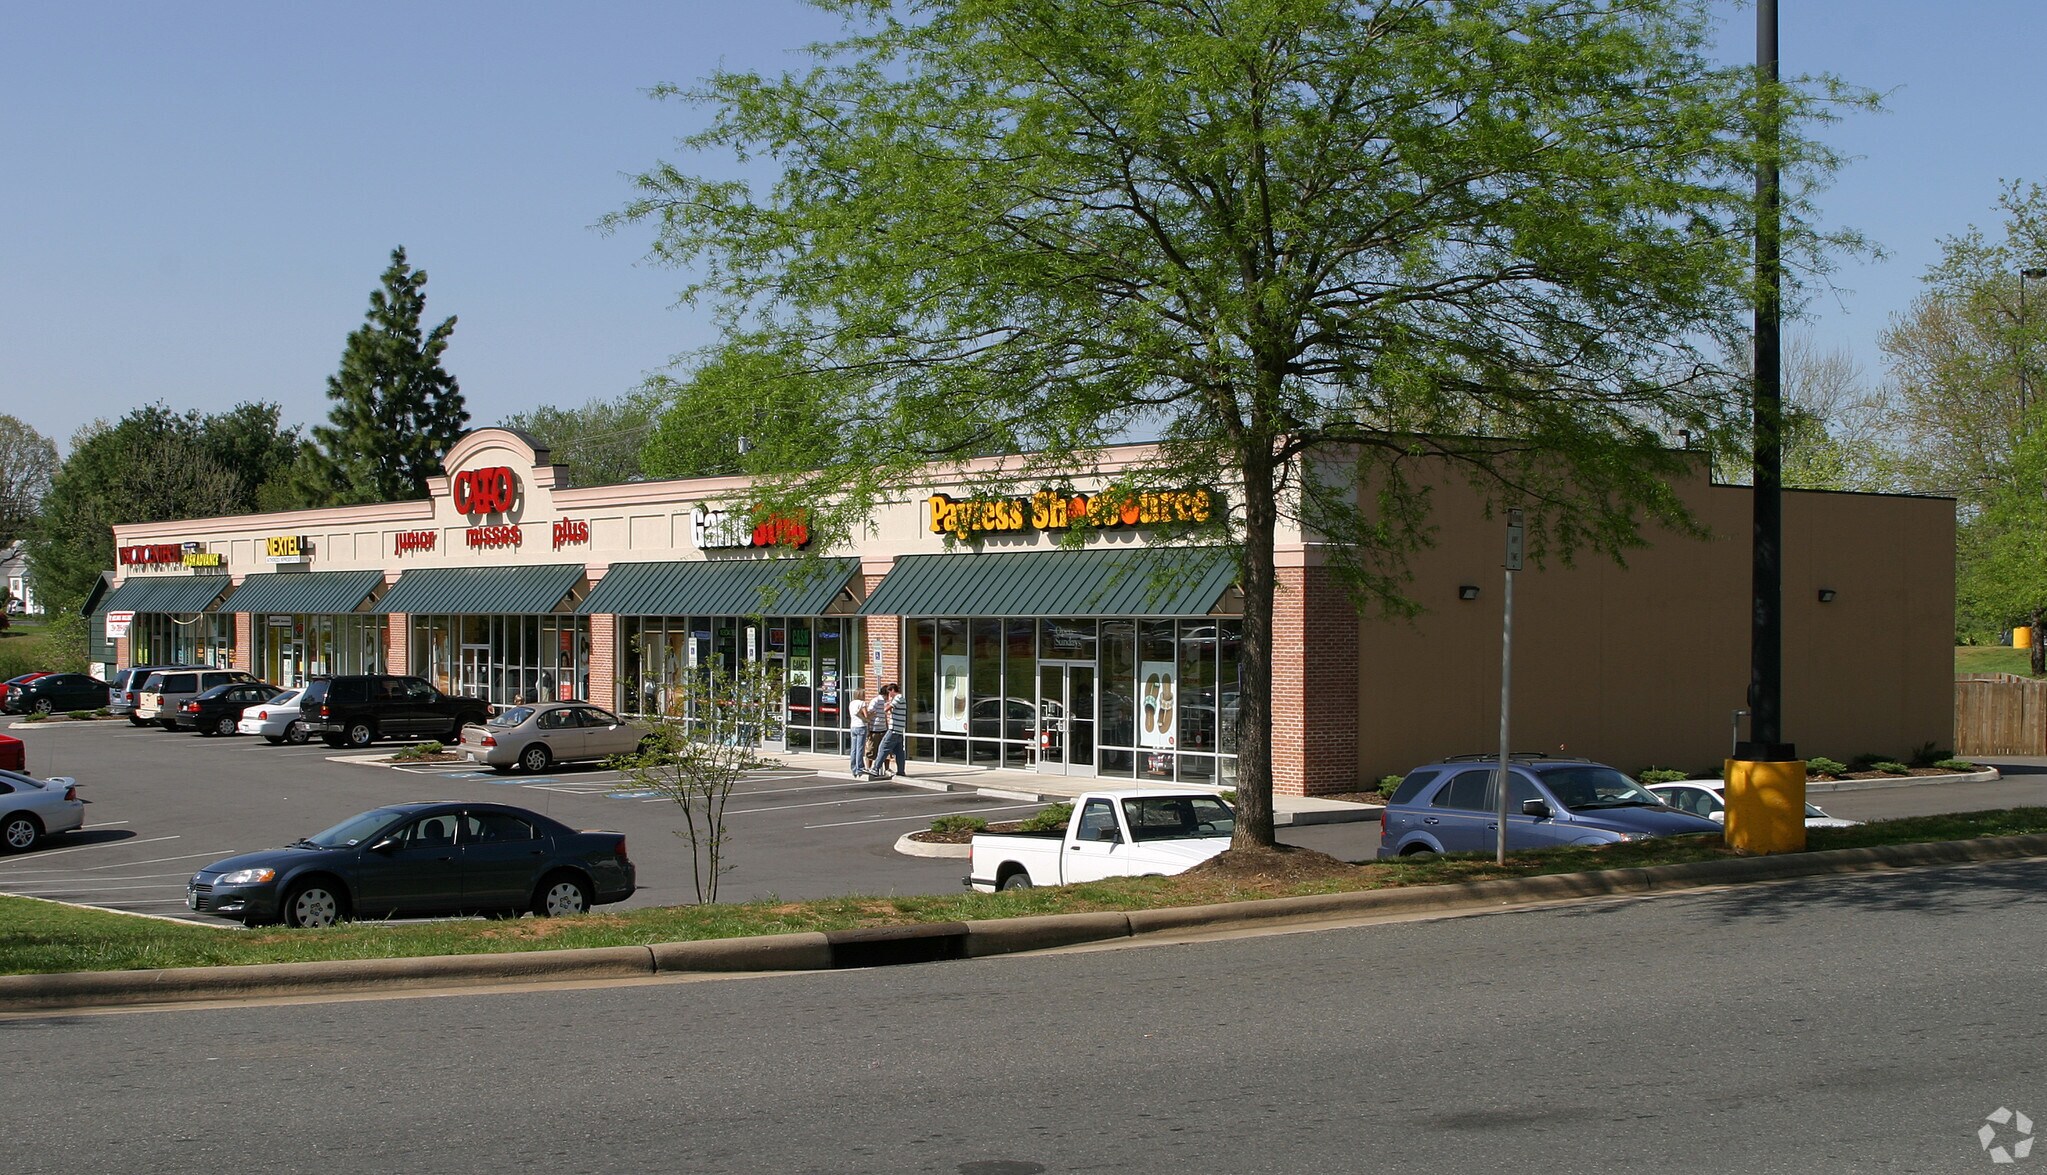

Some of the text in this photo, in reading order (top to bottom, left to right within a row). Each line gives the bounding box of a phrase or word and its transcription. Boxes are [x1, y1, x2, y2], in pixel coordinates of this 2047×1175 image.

[454, 466, 513, 515] CATO
[394, 531, 435, 556] junior
[466, 525, 520, 546] misses
[552, 516, 589, 548] plus
[265, 536, 300, 556] NEXTEL
